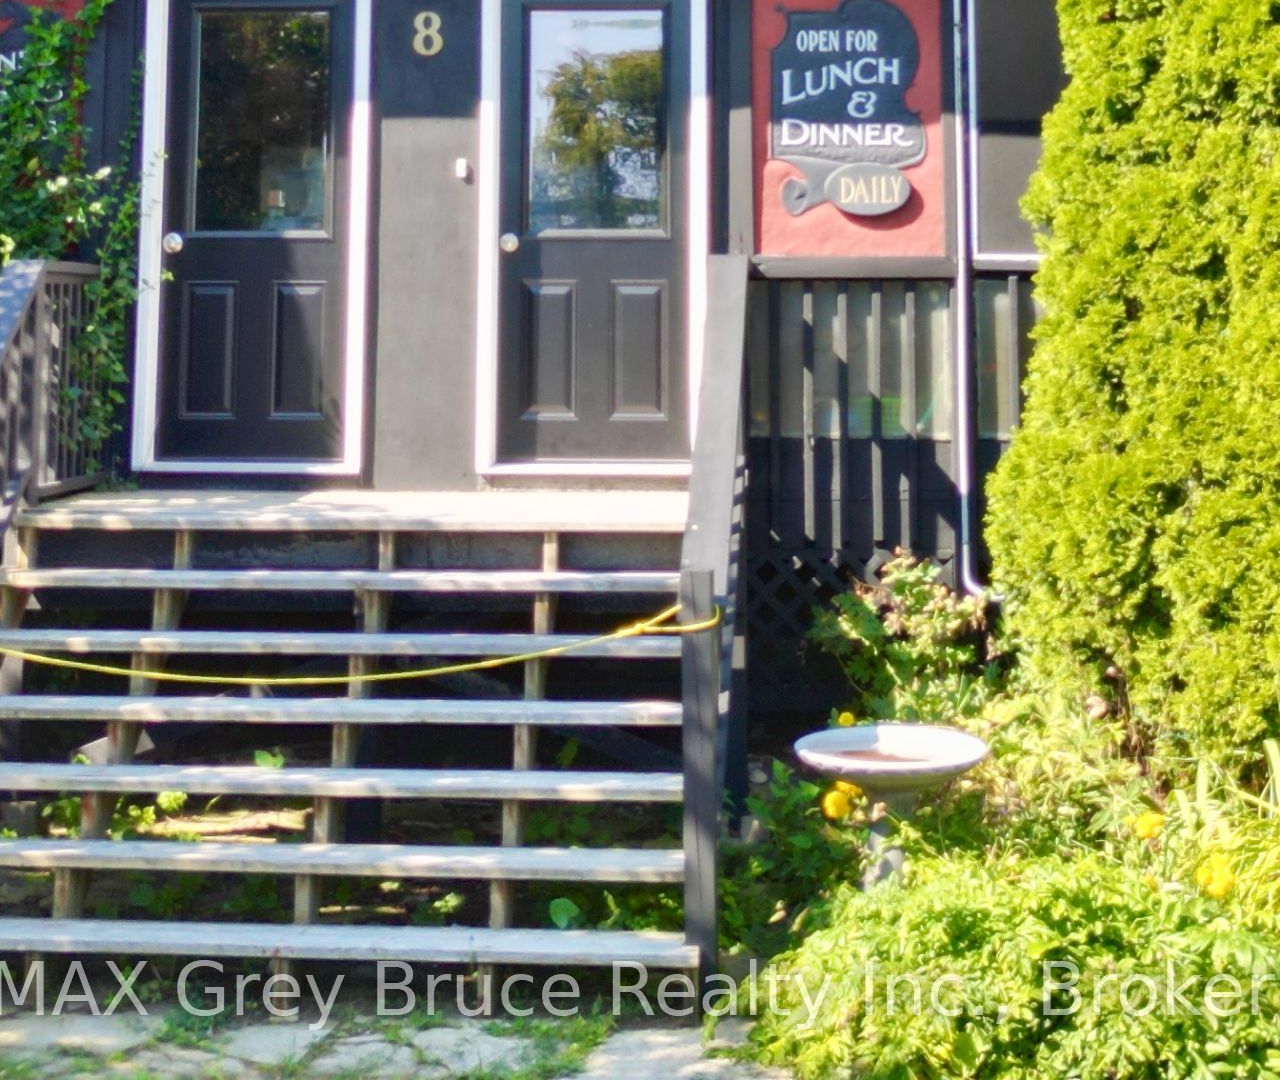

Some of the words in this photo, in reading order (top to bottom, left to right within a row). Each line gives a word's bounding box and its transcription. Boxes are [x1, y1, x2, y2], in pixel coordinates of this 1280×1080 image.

[413, 11, 443, 56] 8
[796, 29, 840, 52] OPEN
[845, 29, 878, 52] FOR
[781, 56, 900, 105] LUNCH
[846, 90, 877, 118] &
[781, 119, 914, 147] DINNER
[840, 176, 903, 204] DAILY
